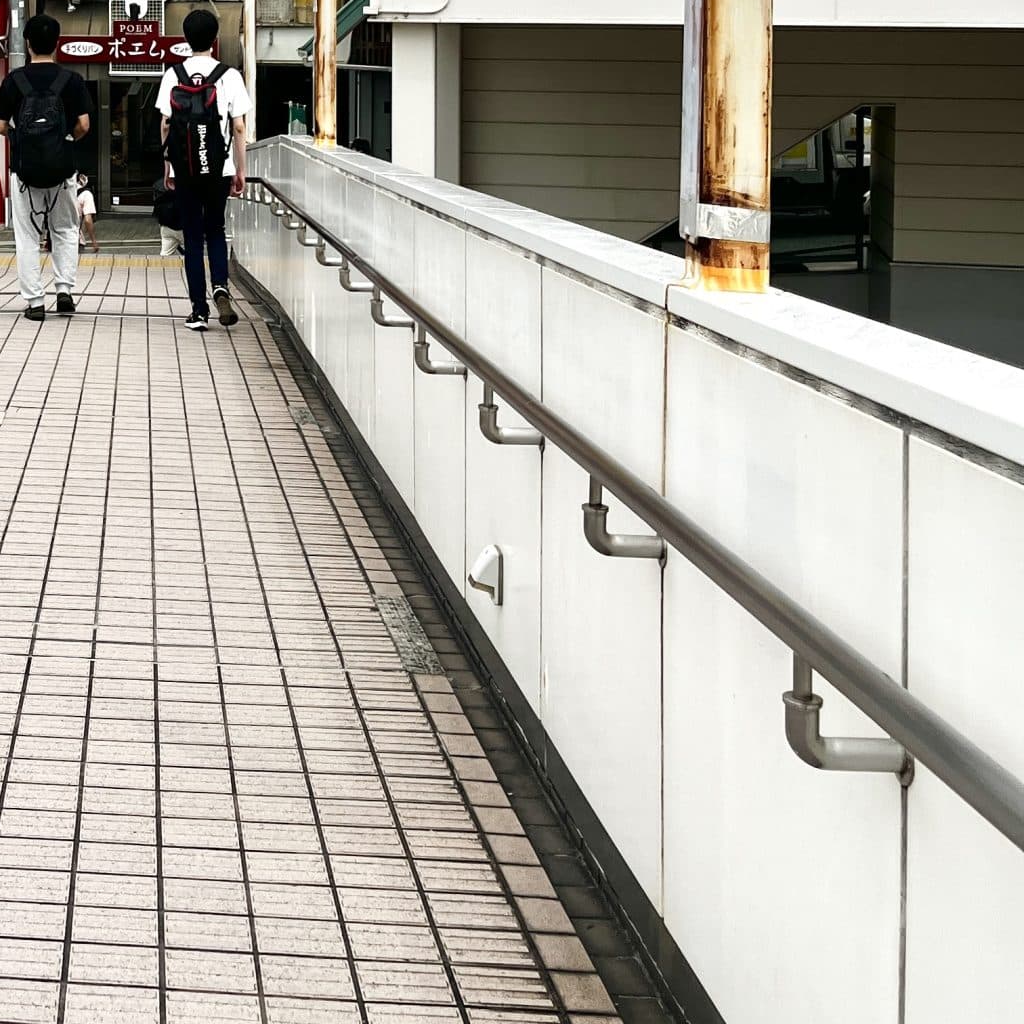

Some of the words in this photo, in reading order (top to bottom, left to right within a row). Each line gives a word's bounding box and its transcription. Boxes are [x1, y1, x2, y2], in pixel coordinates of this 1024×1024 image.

[119, 24, 153, 33] POEM
[108, 38, 165, 59] ポエム
